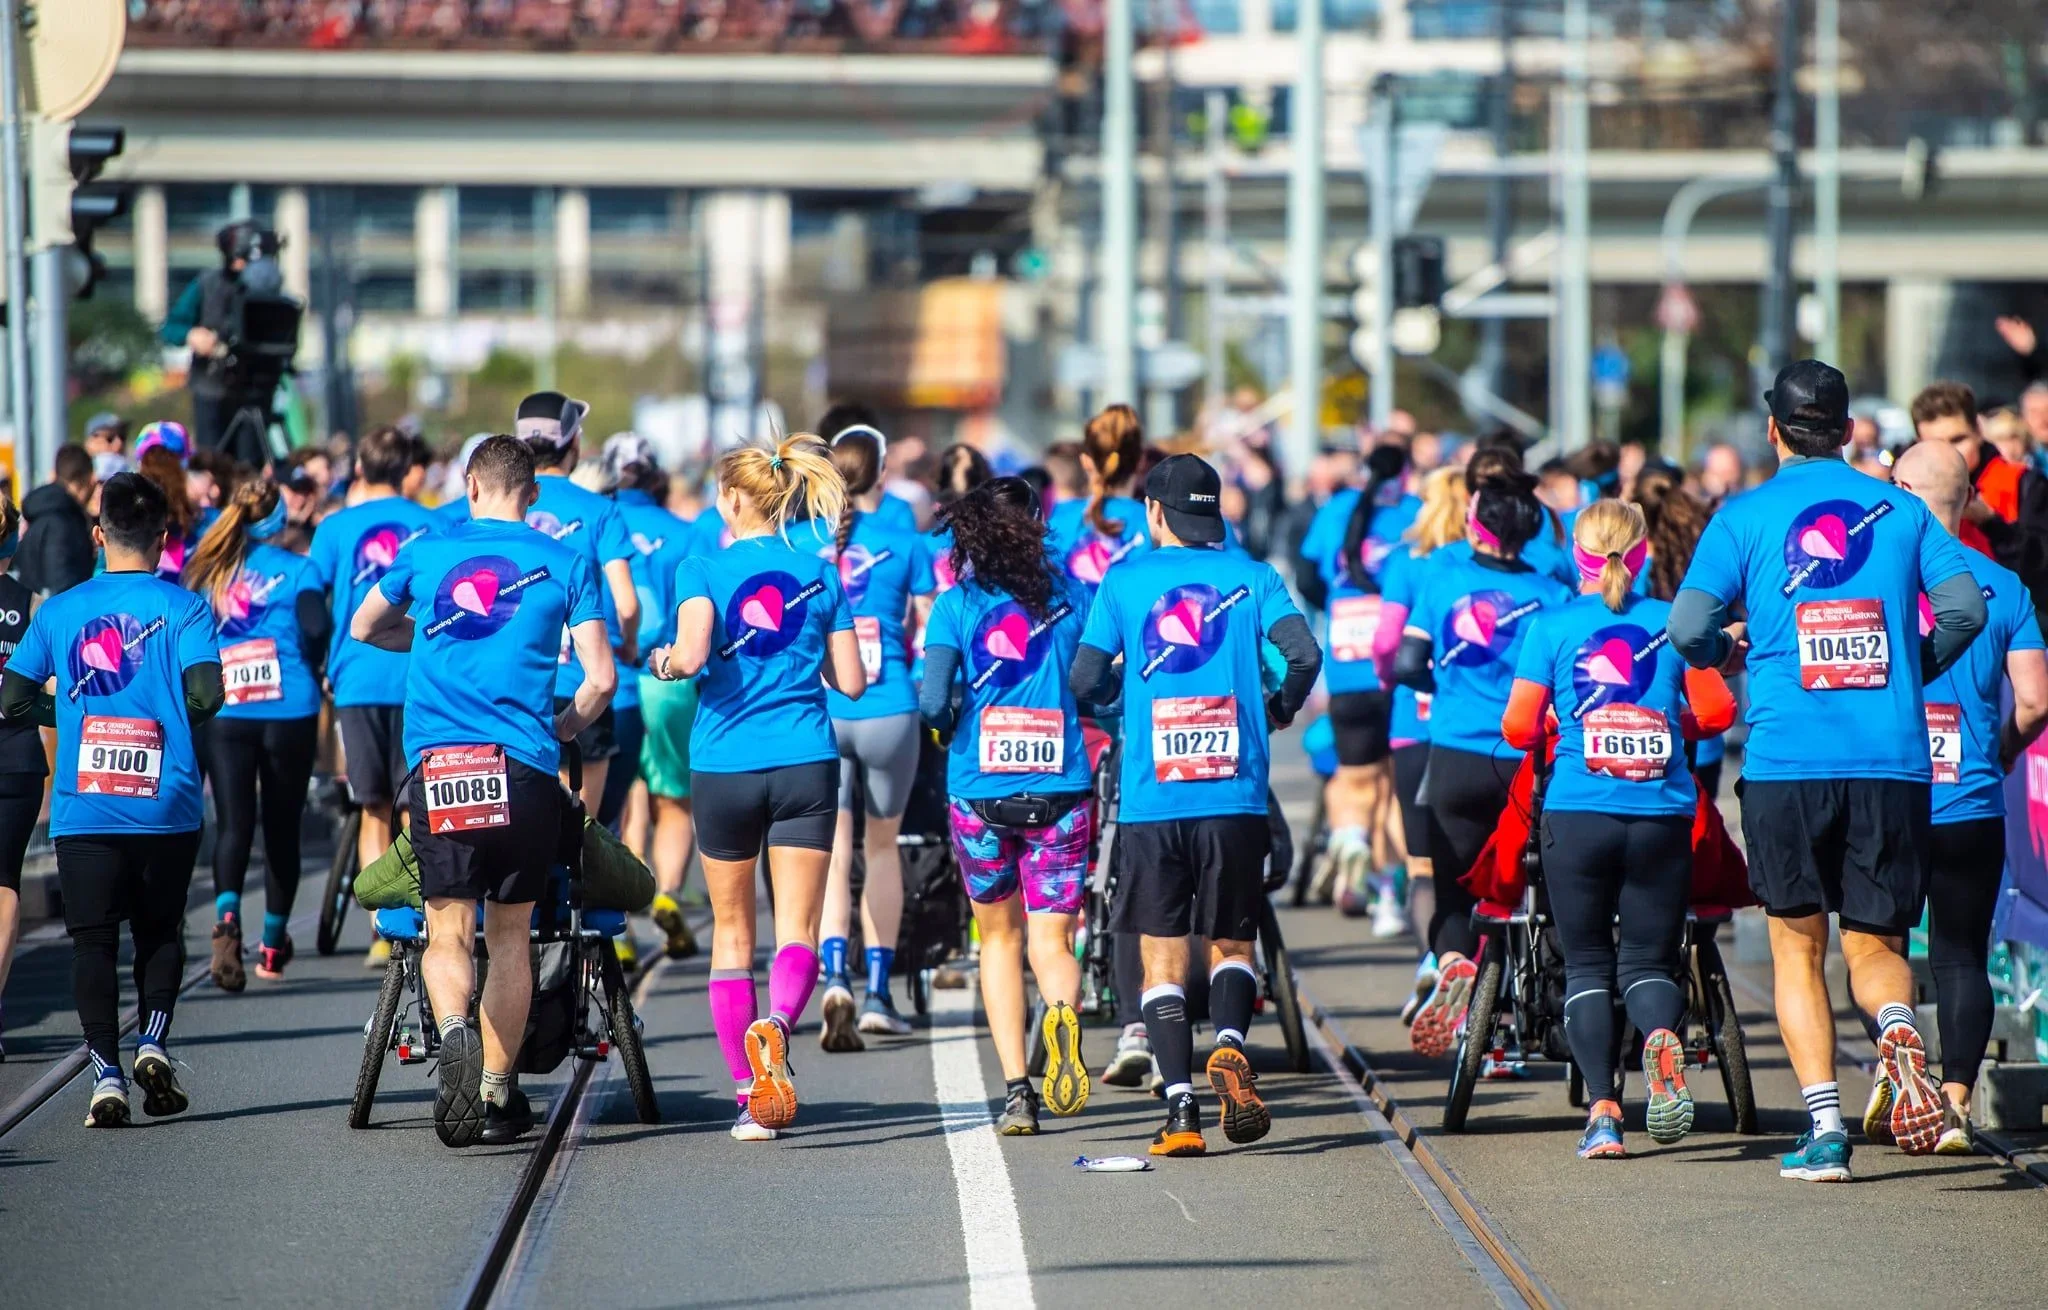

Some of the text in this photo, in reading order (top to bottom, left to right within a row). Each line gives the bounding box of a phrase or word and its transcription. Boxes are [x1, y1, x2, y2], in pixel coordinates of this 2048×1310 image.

[1784, 570, 1808, 594] Running
[1806, 559, 1820, 573] with
[1848, 521, 1865, 536] those
[1863, 513, 1877, 524] that
[426, 618, 452, 636] Running
[451, 610, 466, 622] with
[499, 583, 517, 596] those
[516, 576, 530, 587] that
[1805, 635, 1882, 661] 10452
[988, 740, 1055, 762] F3810
[1161, 730, 1229, 756] 10227
[1592, 735, 1663, 755] F6615
[92, 747, 148, 773] 9100
[430, 777, 501, 807] 10089
